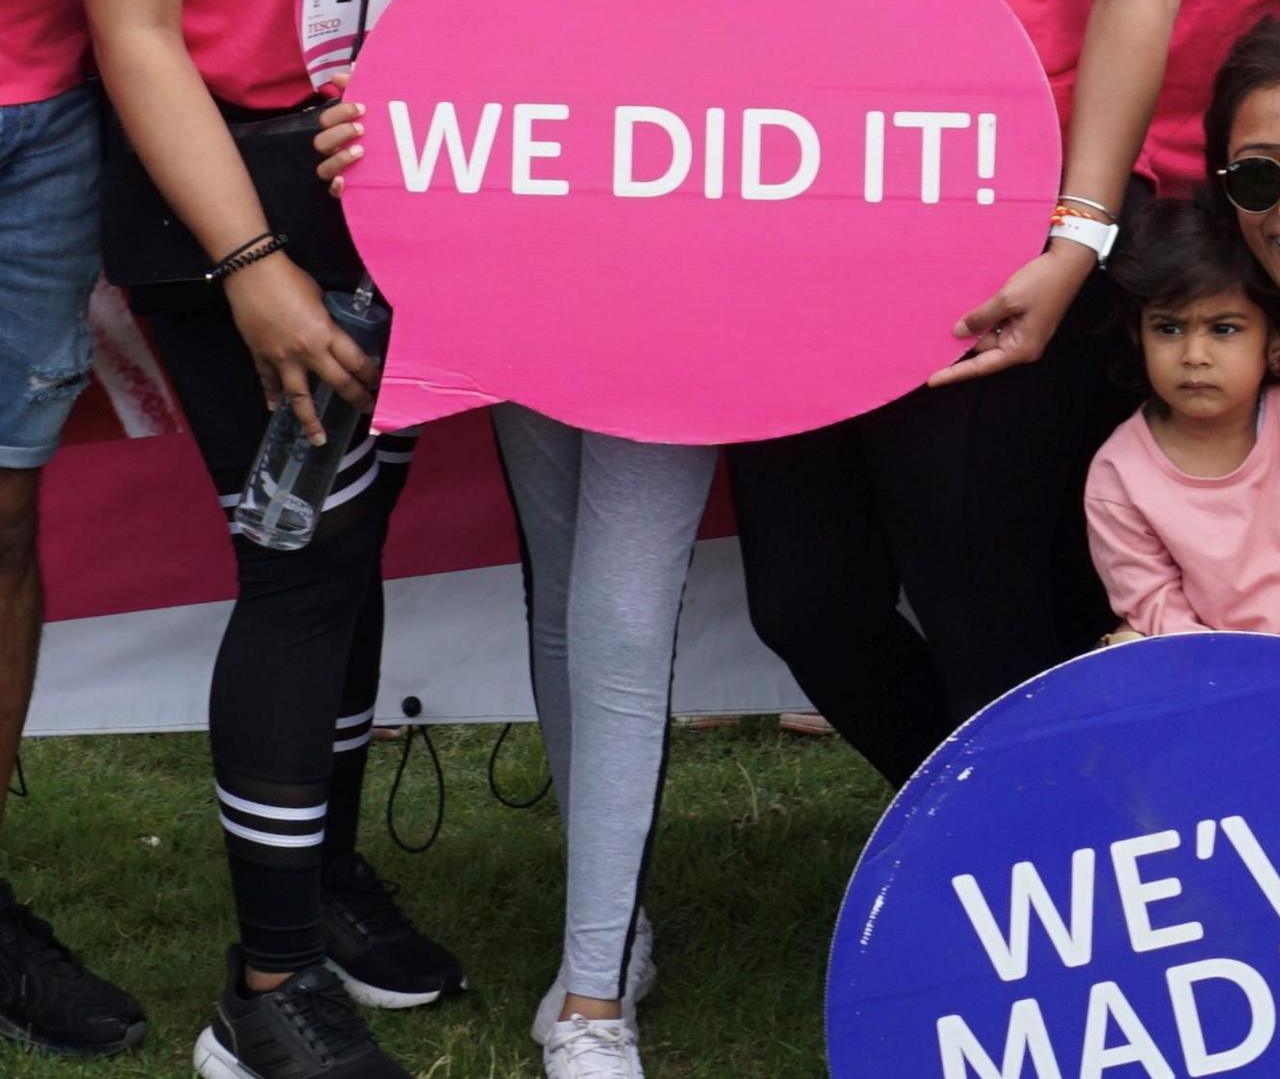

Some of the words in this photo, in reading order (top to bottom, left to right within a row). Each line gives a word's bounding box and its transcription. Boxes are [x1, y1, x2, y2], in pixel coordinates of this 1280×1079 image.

[387, 100, 570, 196] WE
[613, 105, 821, 201] DID
[863, 110, 998, 206] IT!
